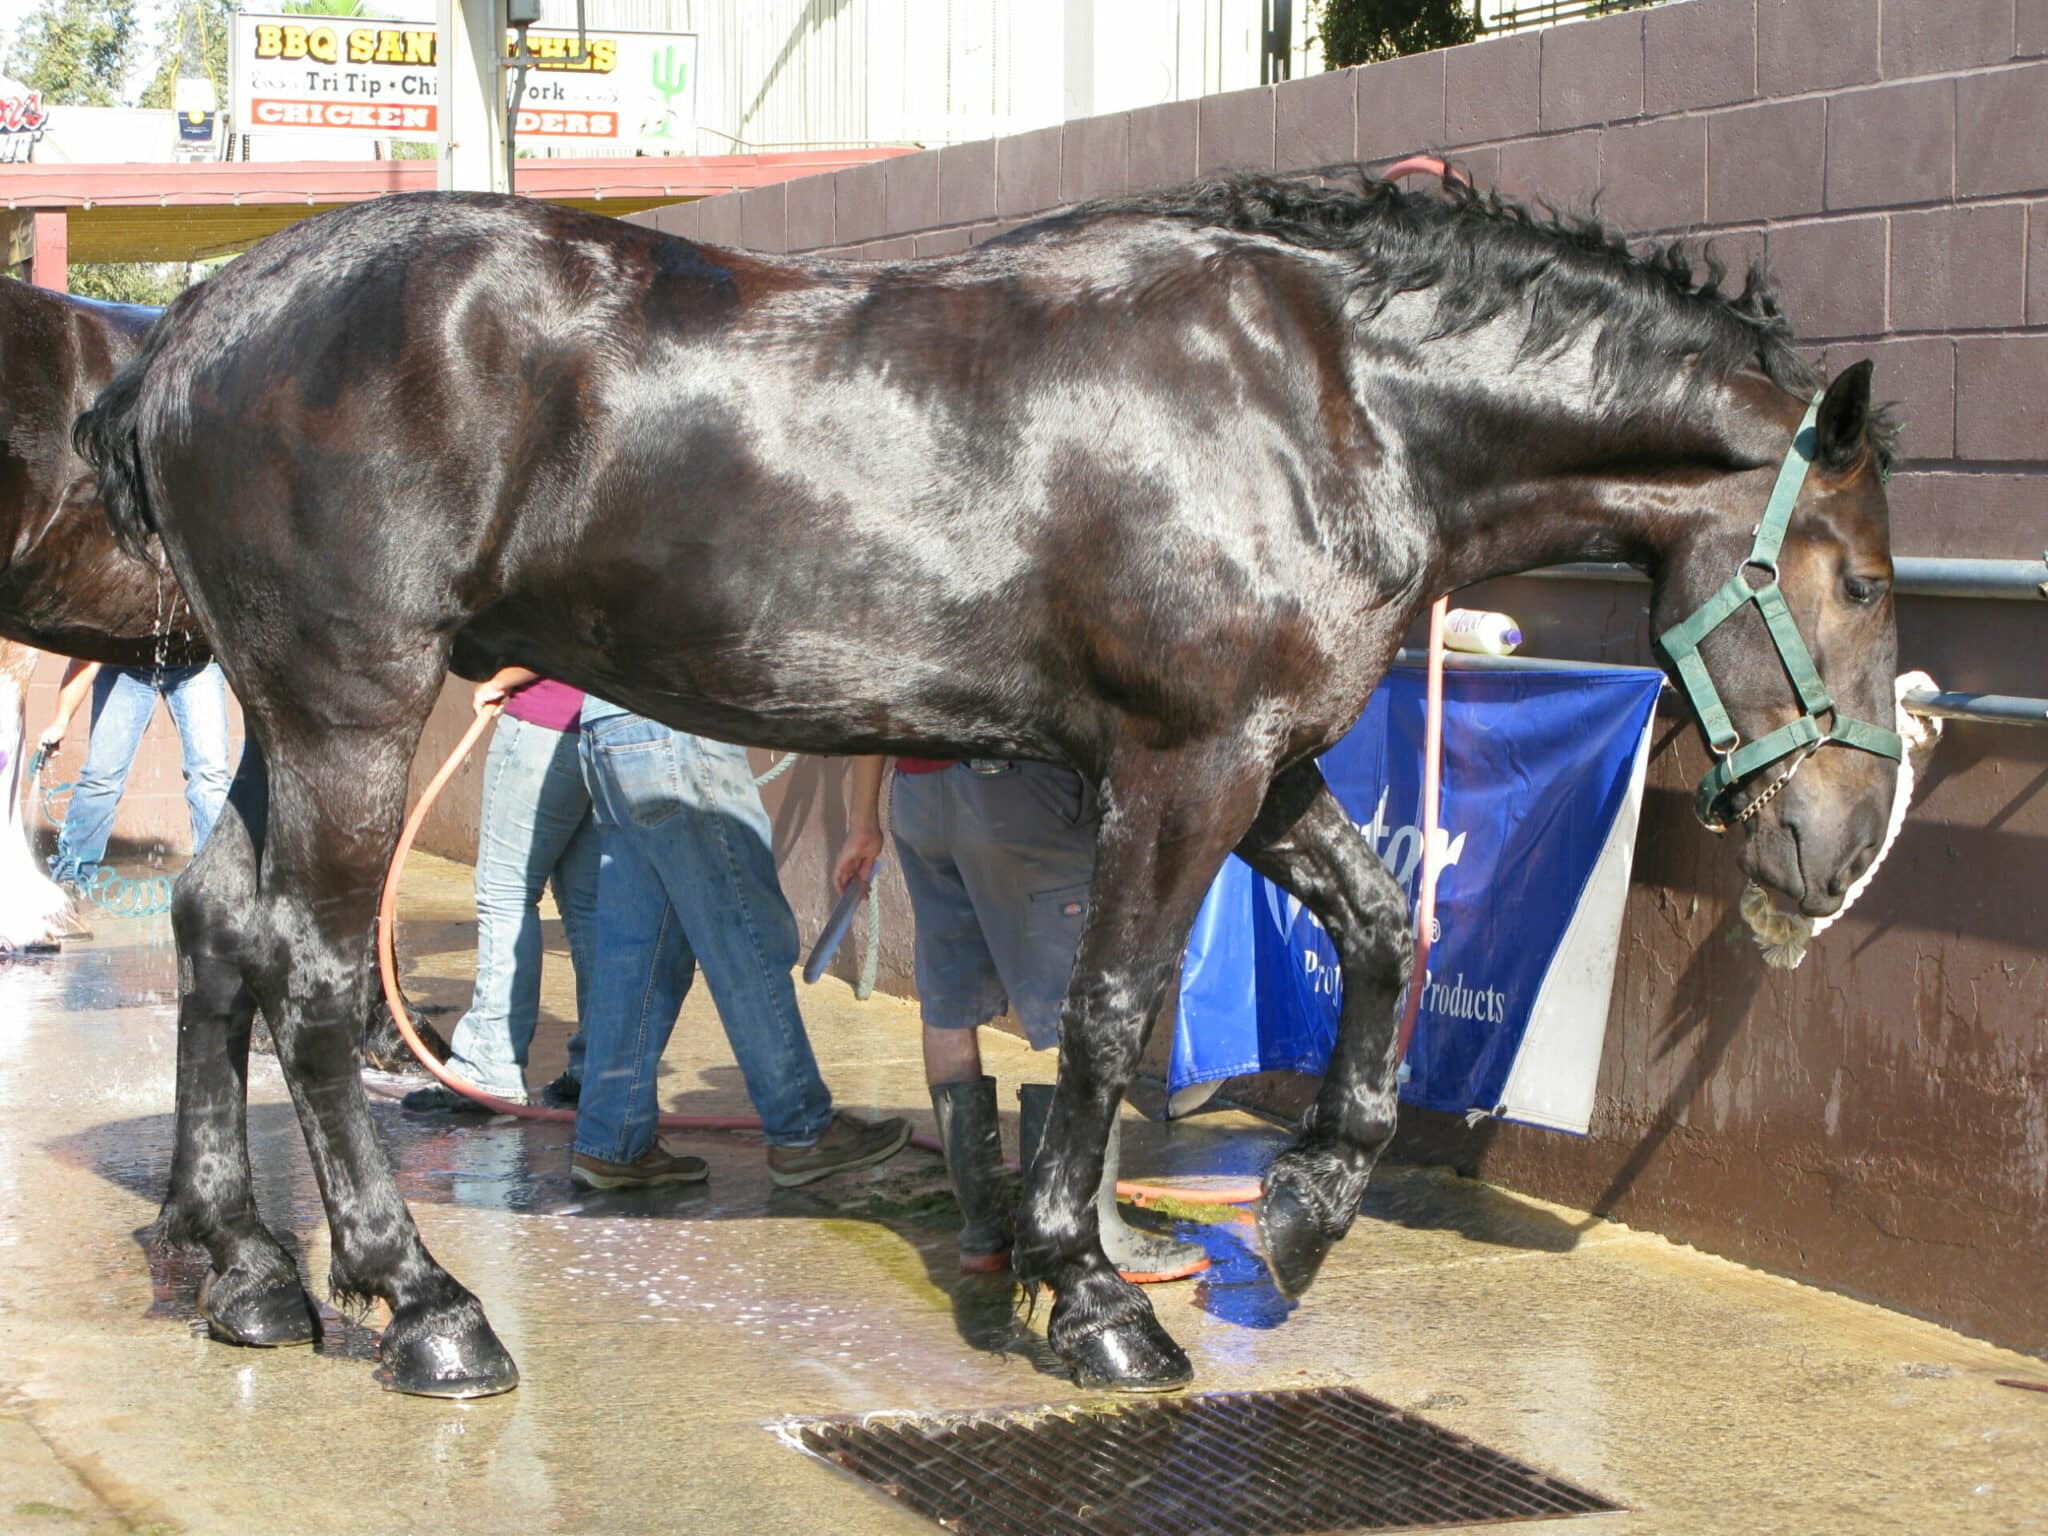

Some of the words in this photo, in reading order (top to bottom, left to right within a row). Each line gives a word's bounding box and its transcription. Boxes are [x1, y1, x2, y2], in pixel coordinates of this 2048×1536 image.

[255, 24, 338, 64] BBQ
[306, 71, 338, 92] Tri
[345, 73, 382, 98] Tip
[528, 81, 565, 100] ork
[257, 101, 430, 128] CHICKEN
[517, 111, 613, 135] DERS
[1419, 968, 1506, 1025] Products
